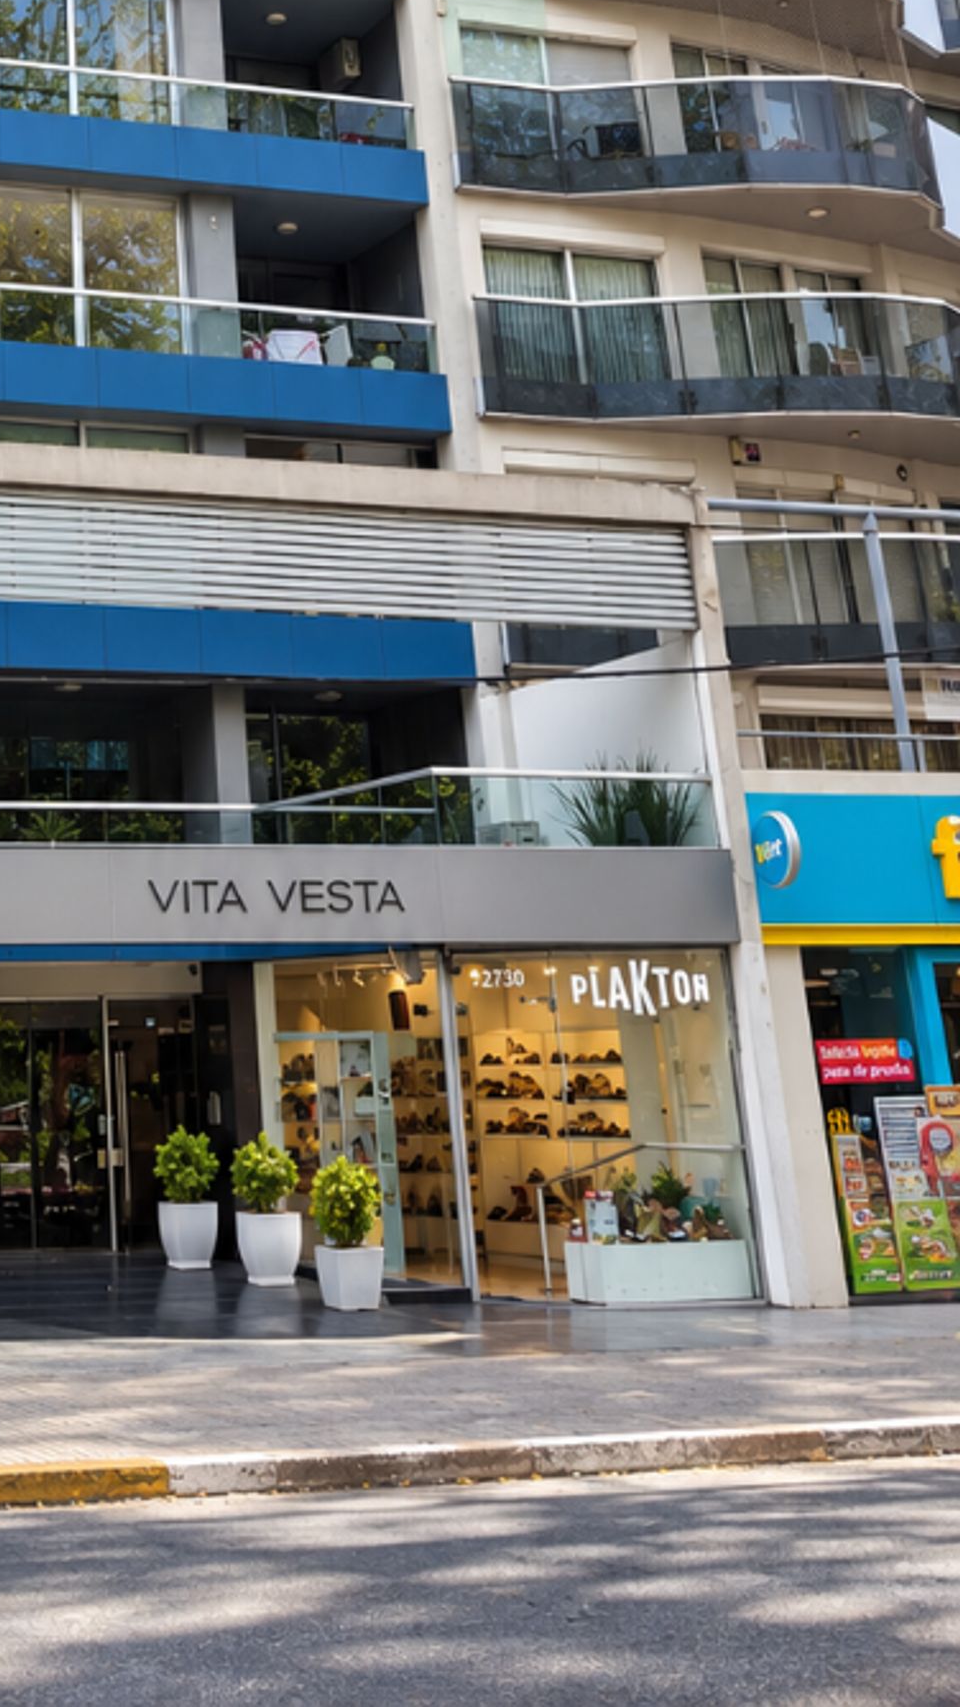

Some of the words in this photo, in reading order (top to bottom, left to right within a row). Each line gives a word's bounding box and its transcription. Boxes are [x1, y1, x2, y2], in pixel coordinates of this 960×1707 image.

[147, 879, 248, 914] VITA
[266, 879, 406, 914] VESTA
[481, 968, 526, 988] 2730
